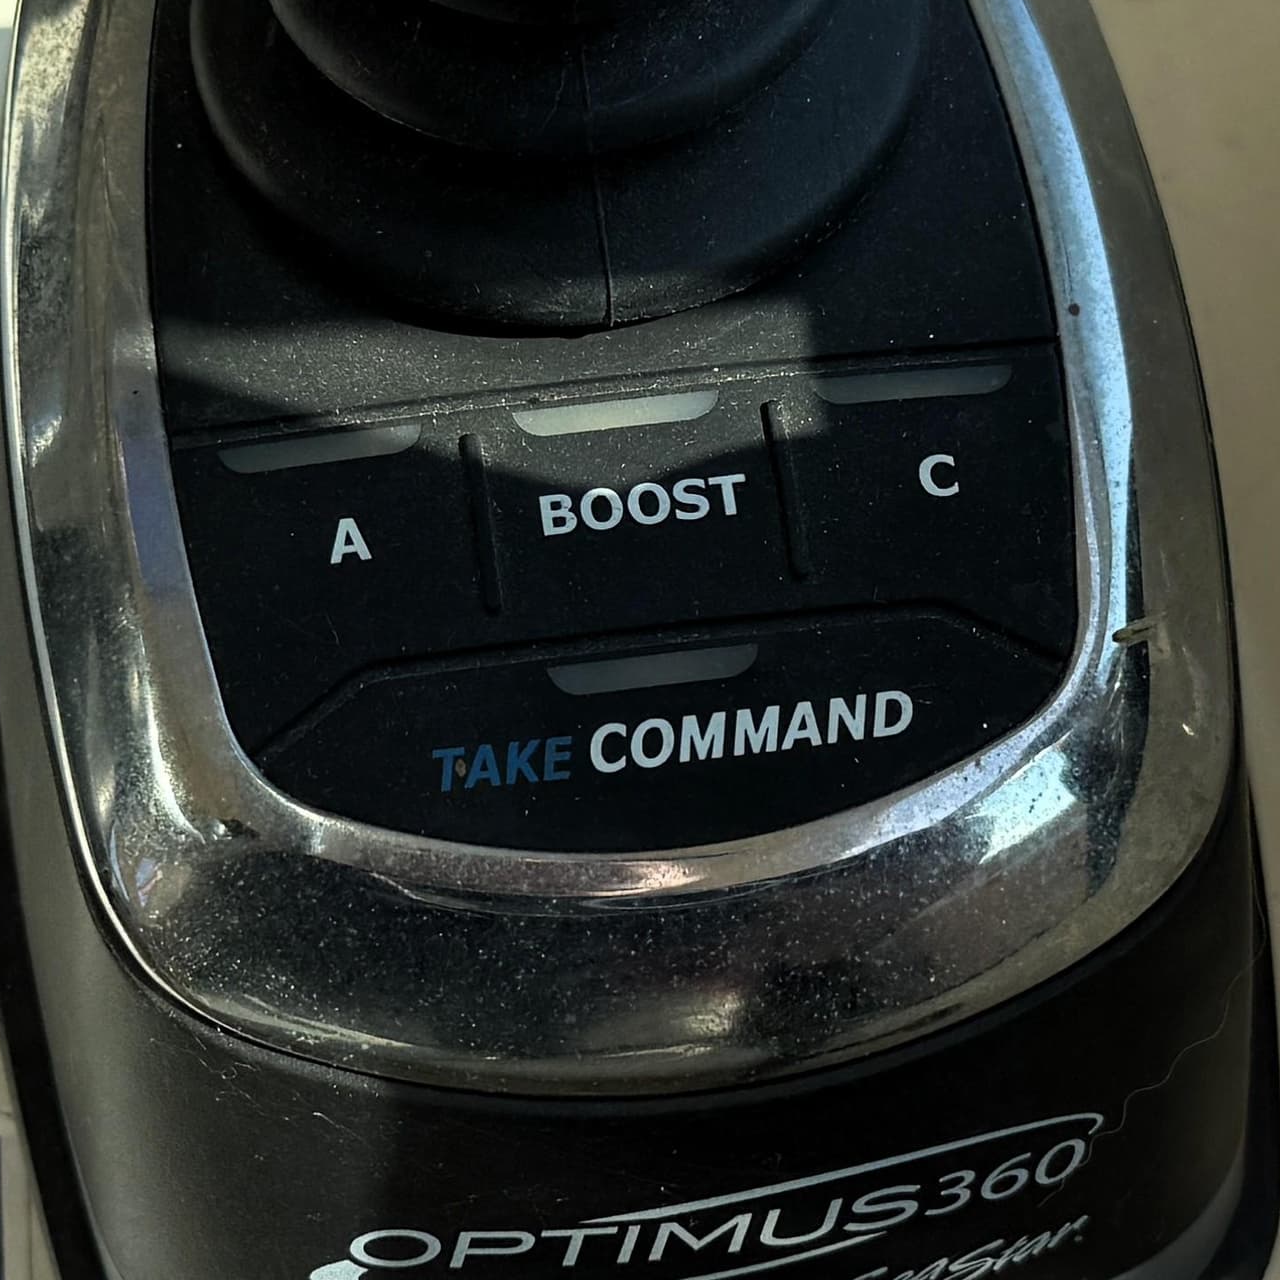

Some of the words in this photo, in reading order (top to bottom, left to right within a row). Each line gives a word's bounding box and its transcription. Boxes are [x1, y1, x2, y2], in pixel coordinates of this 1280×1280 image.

[918, 453, 960, 498] C
[539, 473, 747, 538] BOOST
[329, 516, 372, 565] A
[433, 735, 574, 793] TAKE
[590, 689, 915, 775] COMMAND
